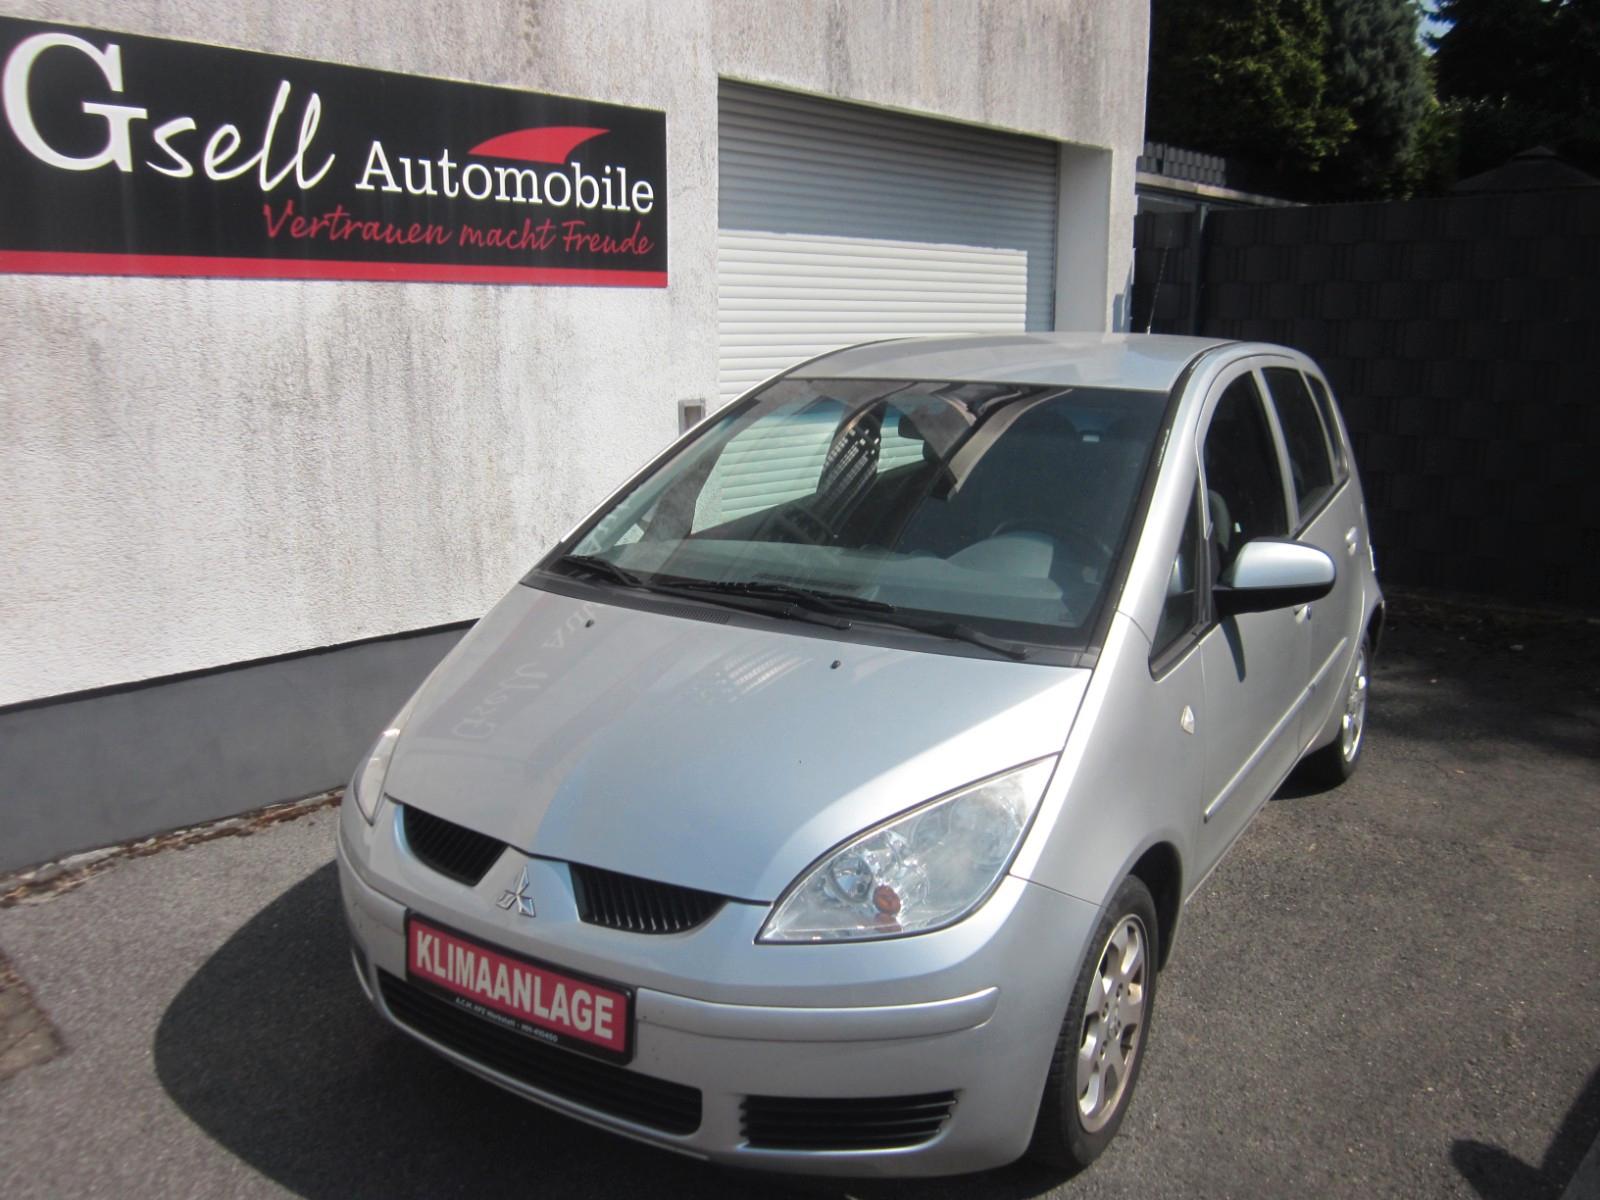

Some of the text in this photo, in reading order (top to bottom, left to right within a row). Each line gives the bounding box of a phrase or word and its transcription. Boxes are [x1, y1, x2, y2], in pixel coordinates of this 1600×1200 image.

[2, 32, 654, 215] Gsell Automobile
[262, 199, 653, 256] Vertrauen macht Freude
[416, 930, 614, 1040] KLIMAANLAGE
